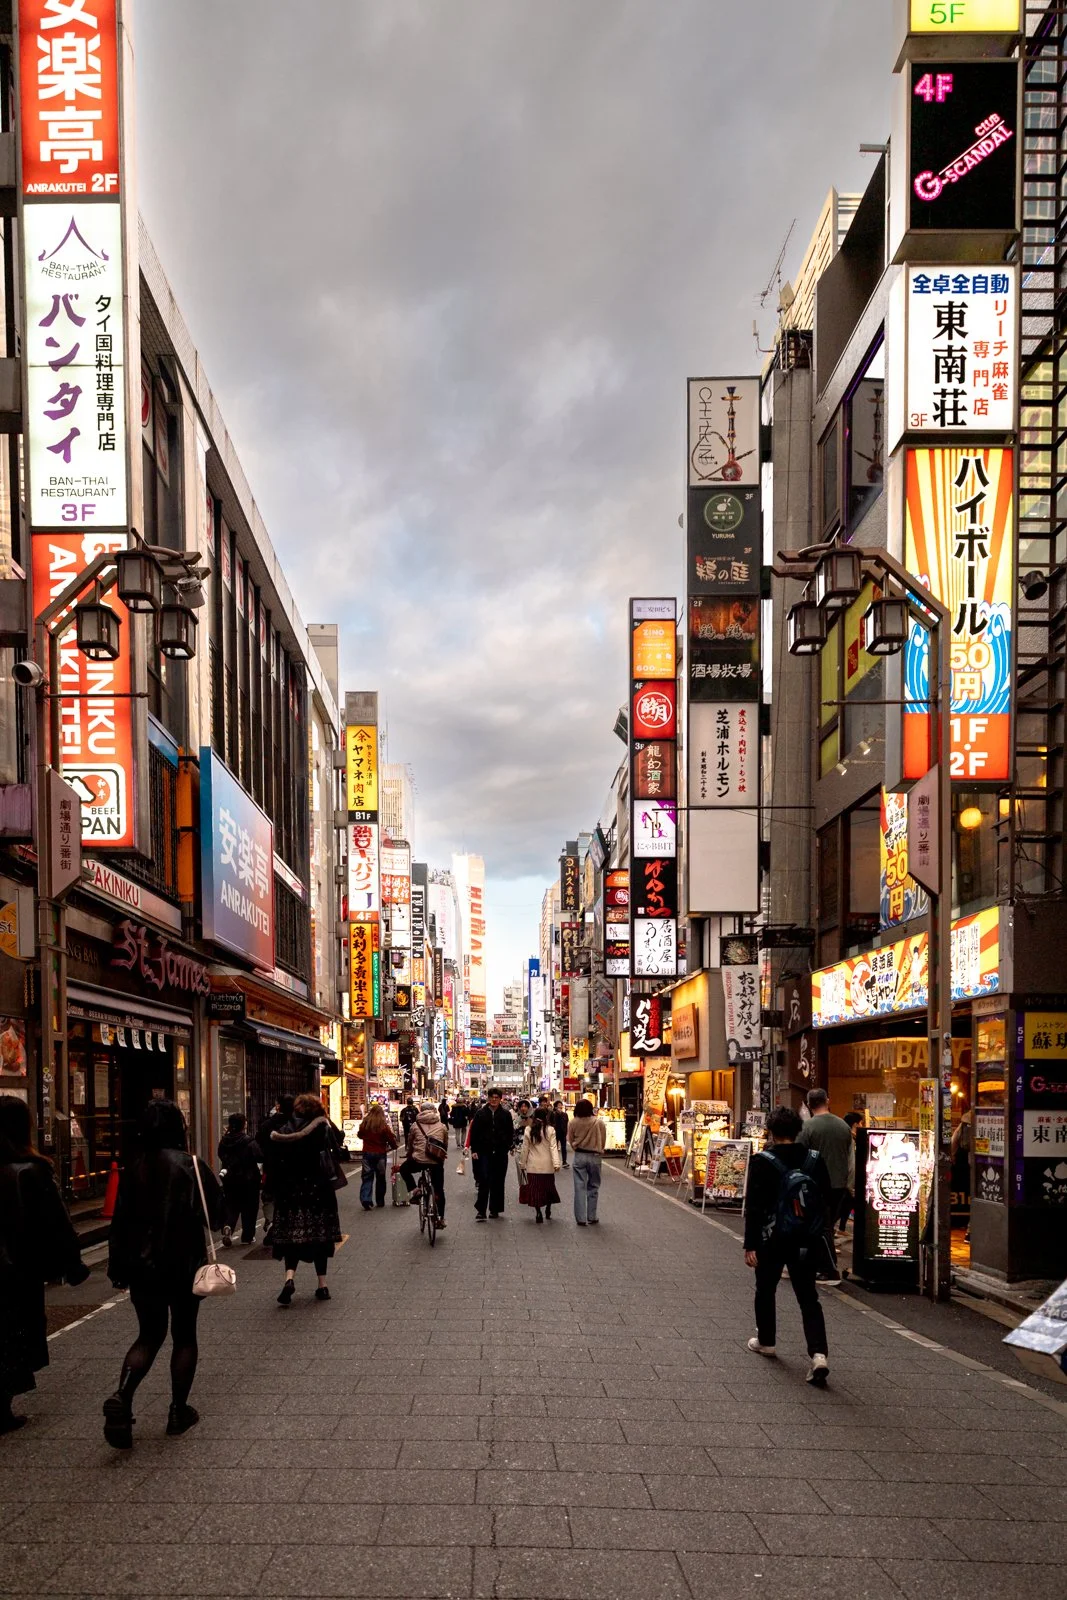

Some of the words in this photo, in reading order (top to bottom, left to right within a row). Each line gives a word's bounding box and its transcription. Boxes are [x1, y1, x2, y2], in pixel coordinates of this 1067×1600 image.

[930, 3, 965, 24] 5F
[914, 73, 953, 103] 4F
[974, 112, 1001, 137] CLUB
[914, 124, 1013, 200] G-SCANDAL
[26, 183, 87, 193] ANRAKUTEI
[91, 173, 118, 192] 2F
[41, 265, 107, 281] RESTAURANT
[49, 260, 99, 273] BAN-THAI
[912, 274, 1009, 294] 全卓全自動
[992, 299, 1009, 401] リーチ麻雀
[95, 294, 116, 452] タイ国料理専門店
[932, 300, 968, 428] 東南荘
[38, 293, 86, 464] バンタイ
[973, 341, 989, 416] 専門店
[911, 413, 928, 427] 3F
[41, 488, 116, 497] RESTAURANT
[49, 476, 108, 486] BAN-THAI
[61, 503, 97, 522] 3F
[953, 456, 990, 635] ハイボール
[691, 664, 752, 678] 酒場牧場
[954, 671, 982, 701] 円
[716, 708, 730, 798] 芝浦ホルモン
[949, 752, 989, 776] 2F
[352, 745, 365, 807] ヤマネ肉店
[91, 807, 116, 815] BEEF
[355, 811, 371, 820] B1F
[60, 798, 72, 870] 劇場通り一番街
[219, 806, 269, 899] 安楽亭
[221, 880, 270, 936] ANRAKUTEI
[356, 911, 372, 921] 4F
[736, 972, 760, 1040] お好み焼き
[853, 1042, 896, 1070] TEPPAN
[712, 1188, 737, 1198] BABY
